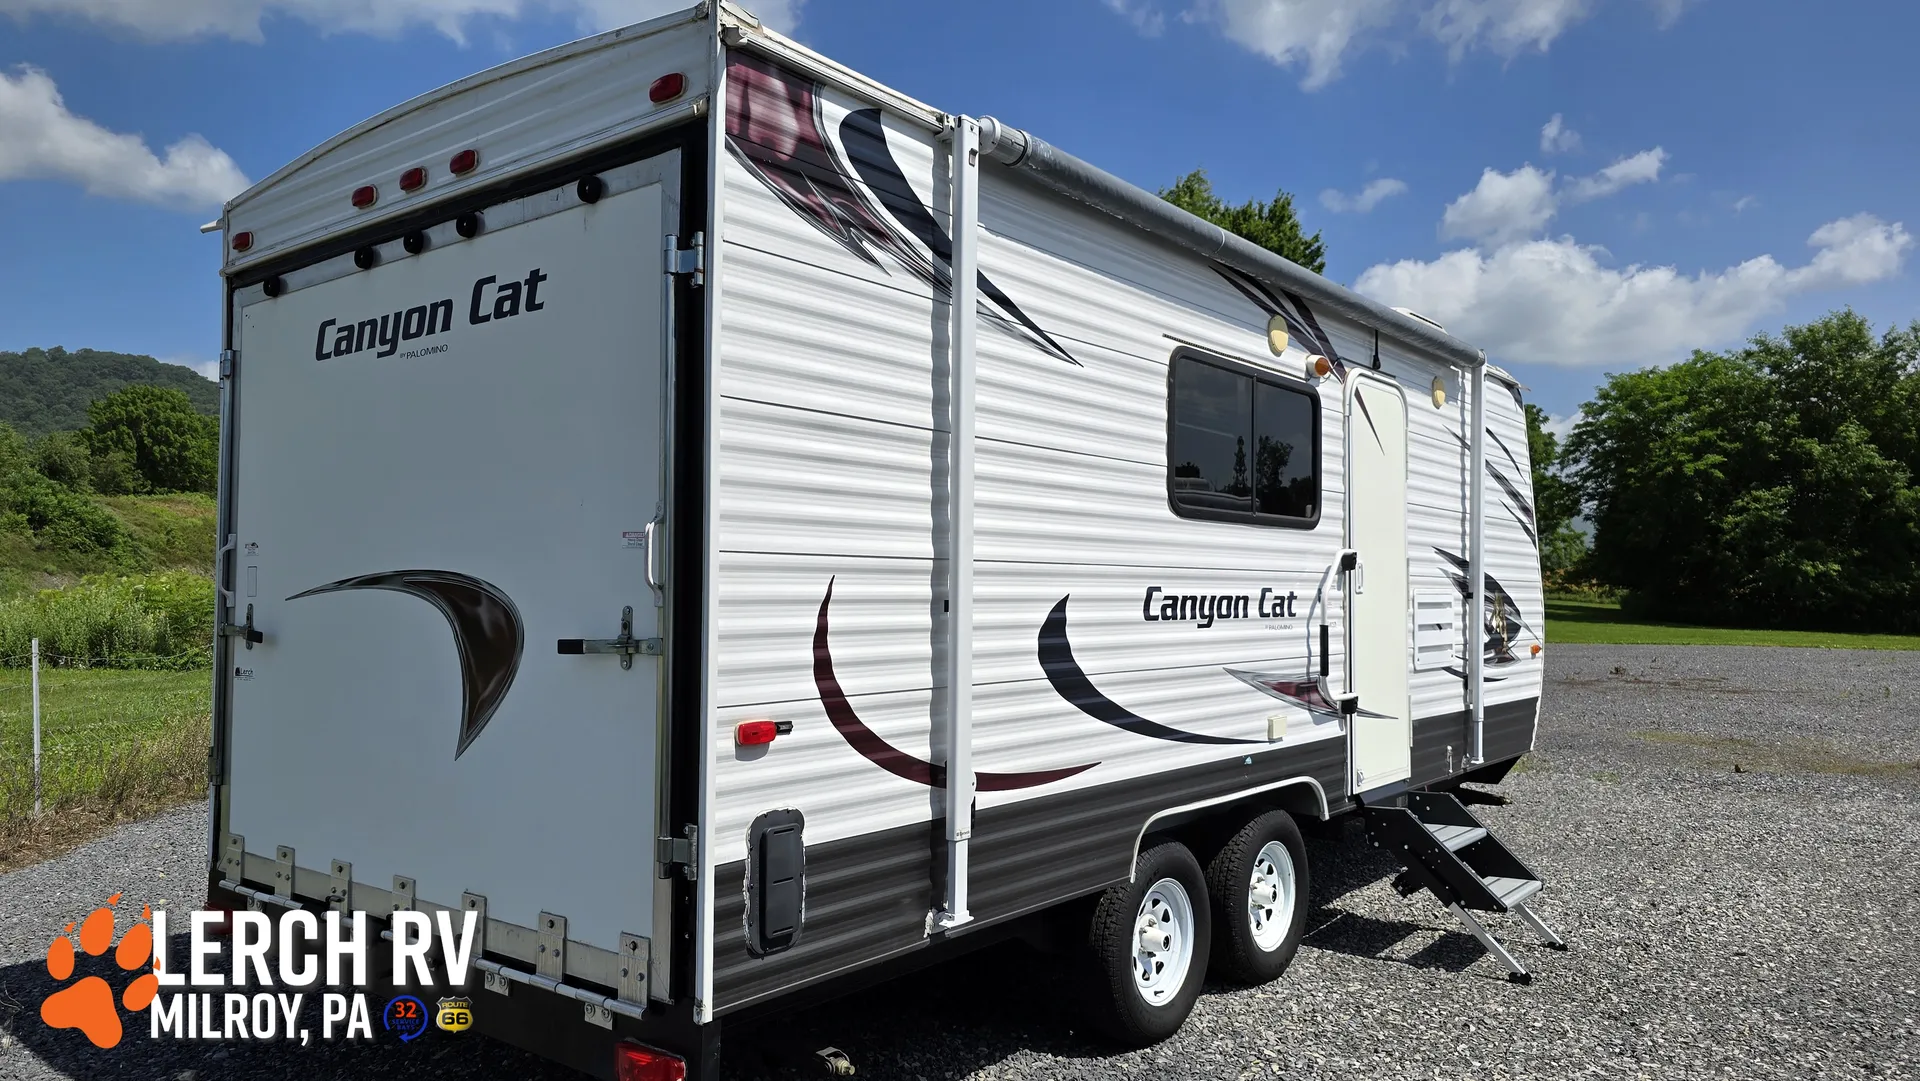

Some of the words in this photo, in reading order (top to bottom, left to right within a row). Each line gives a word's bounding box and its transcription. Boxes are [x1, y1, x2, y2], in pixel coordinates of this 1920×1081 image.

[315, 298, 453, 361] Canyon
[469, 268, 547, 325] Cat
[407, 344, 448, 359] PALOMINO
[1143, 586, 1249, 628] Canyon
[1258, 587, 1298, 617] Cat
